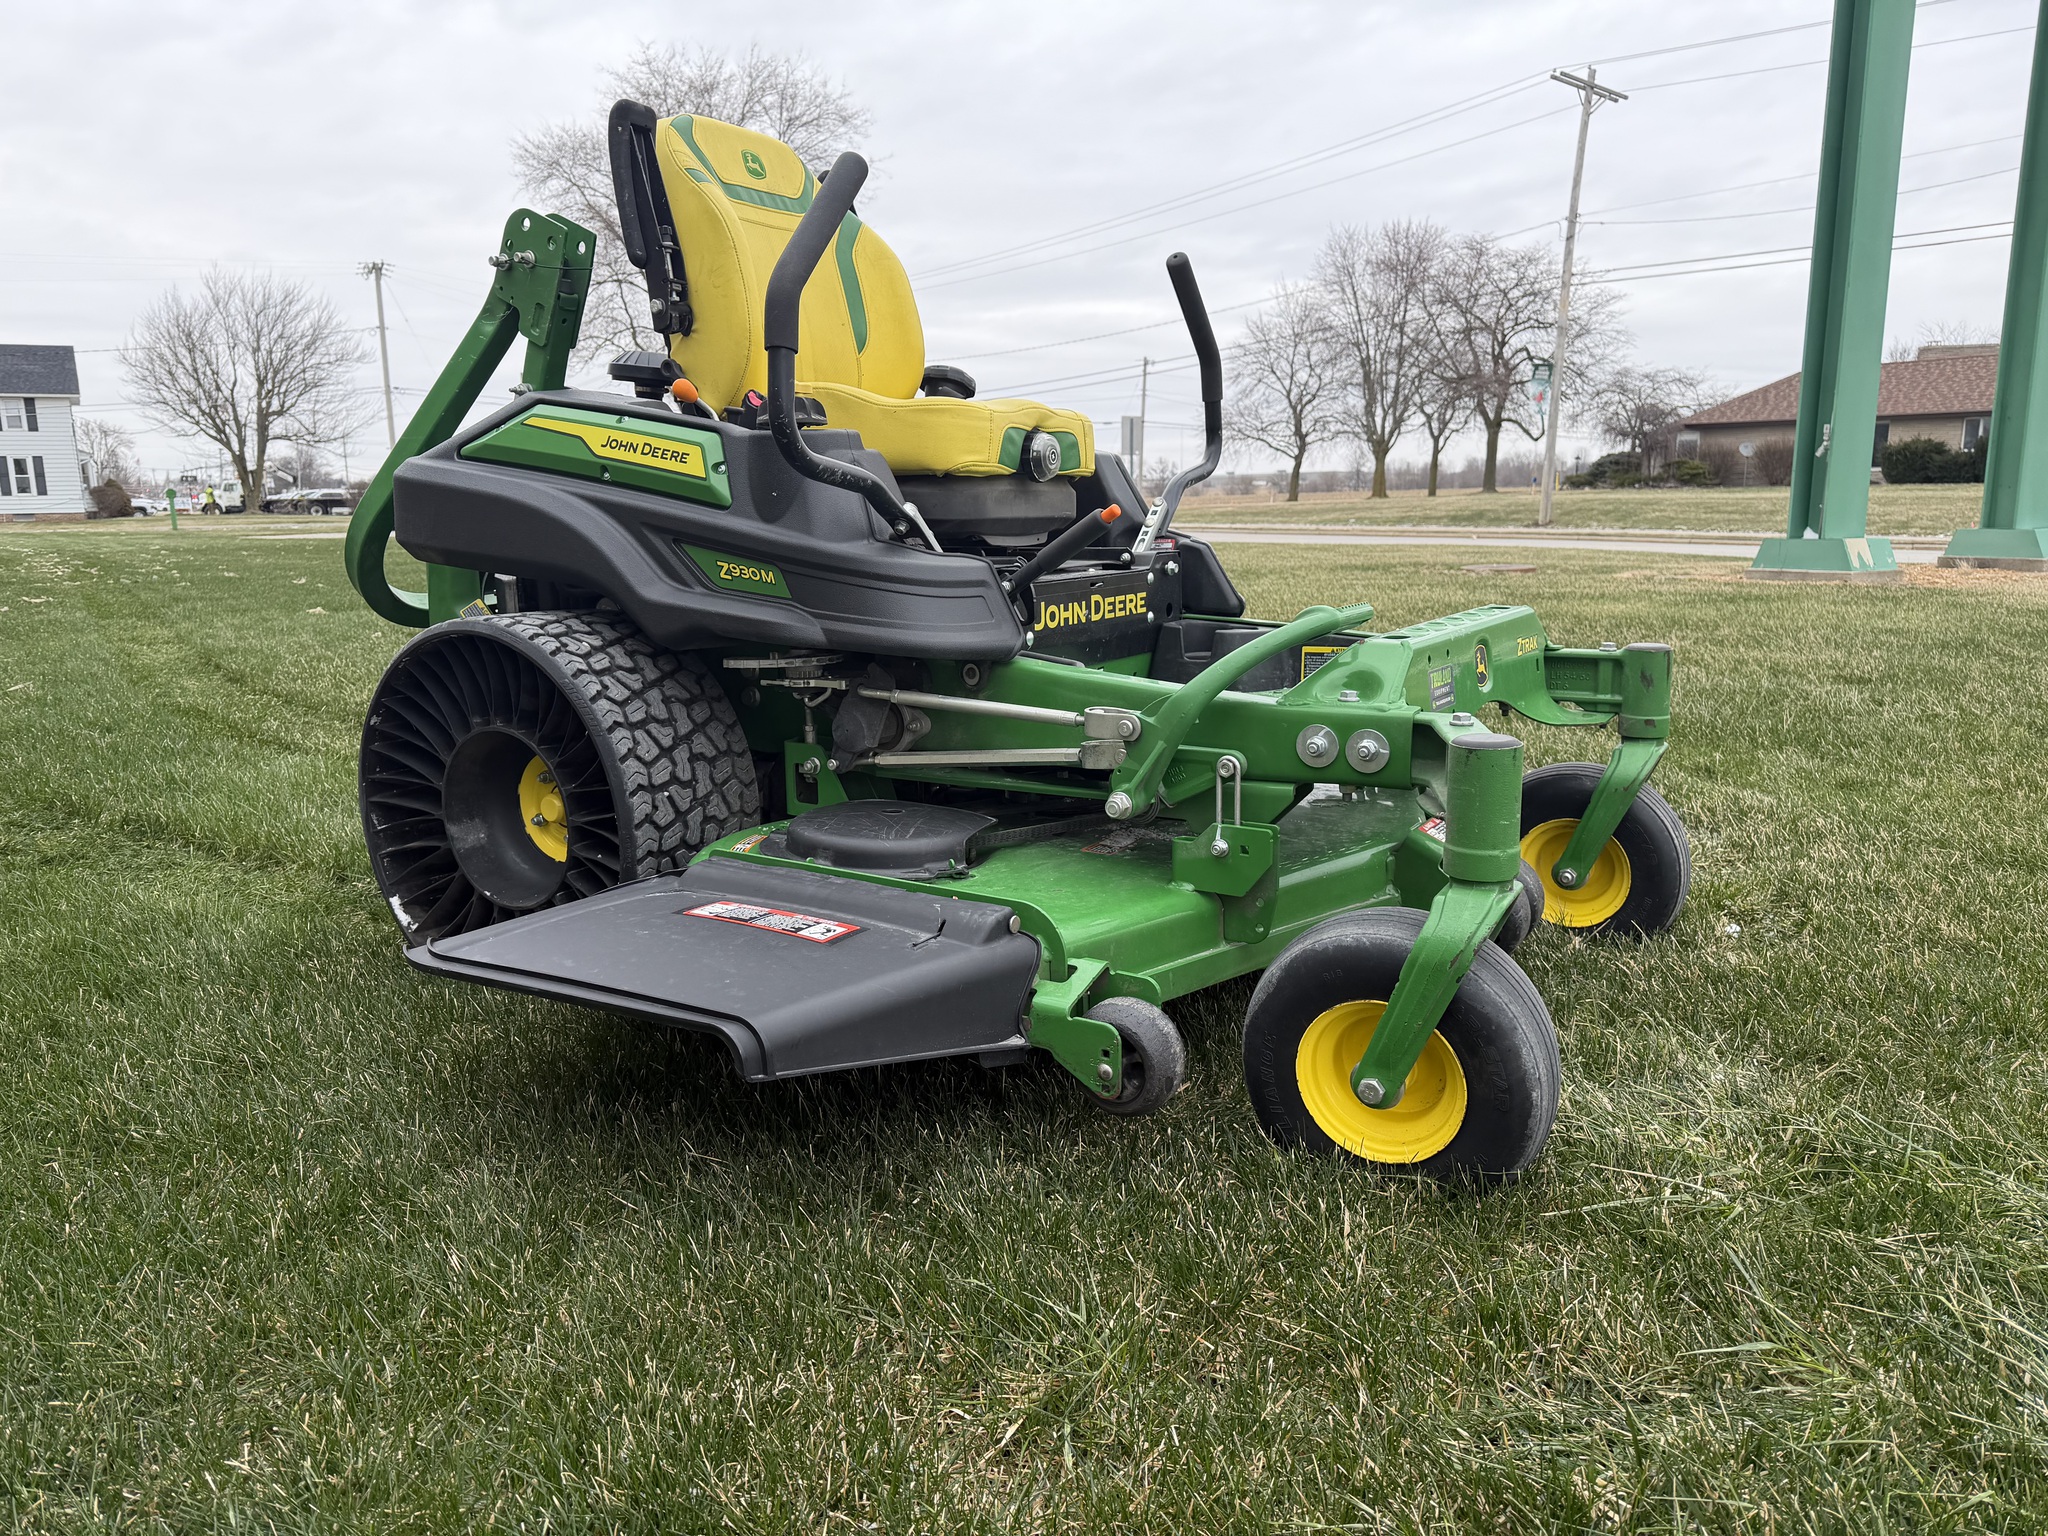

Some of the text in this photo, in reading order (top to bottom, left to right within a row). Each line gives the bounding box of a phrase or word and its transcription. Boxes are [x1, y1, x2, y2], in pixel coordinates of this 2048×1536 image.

[600, 434, 690, 465] JOHN DEERE
[716, 560, 776, 586] Z930M
[1034, 591, 1147, 631] JOHN DEERE
[1516, 634, 1538, 656] ZTRAK
